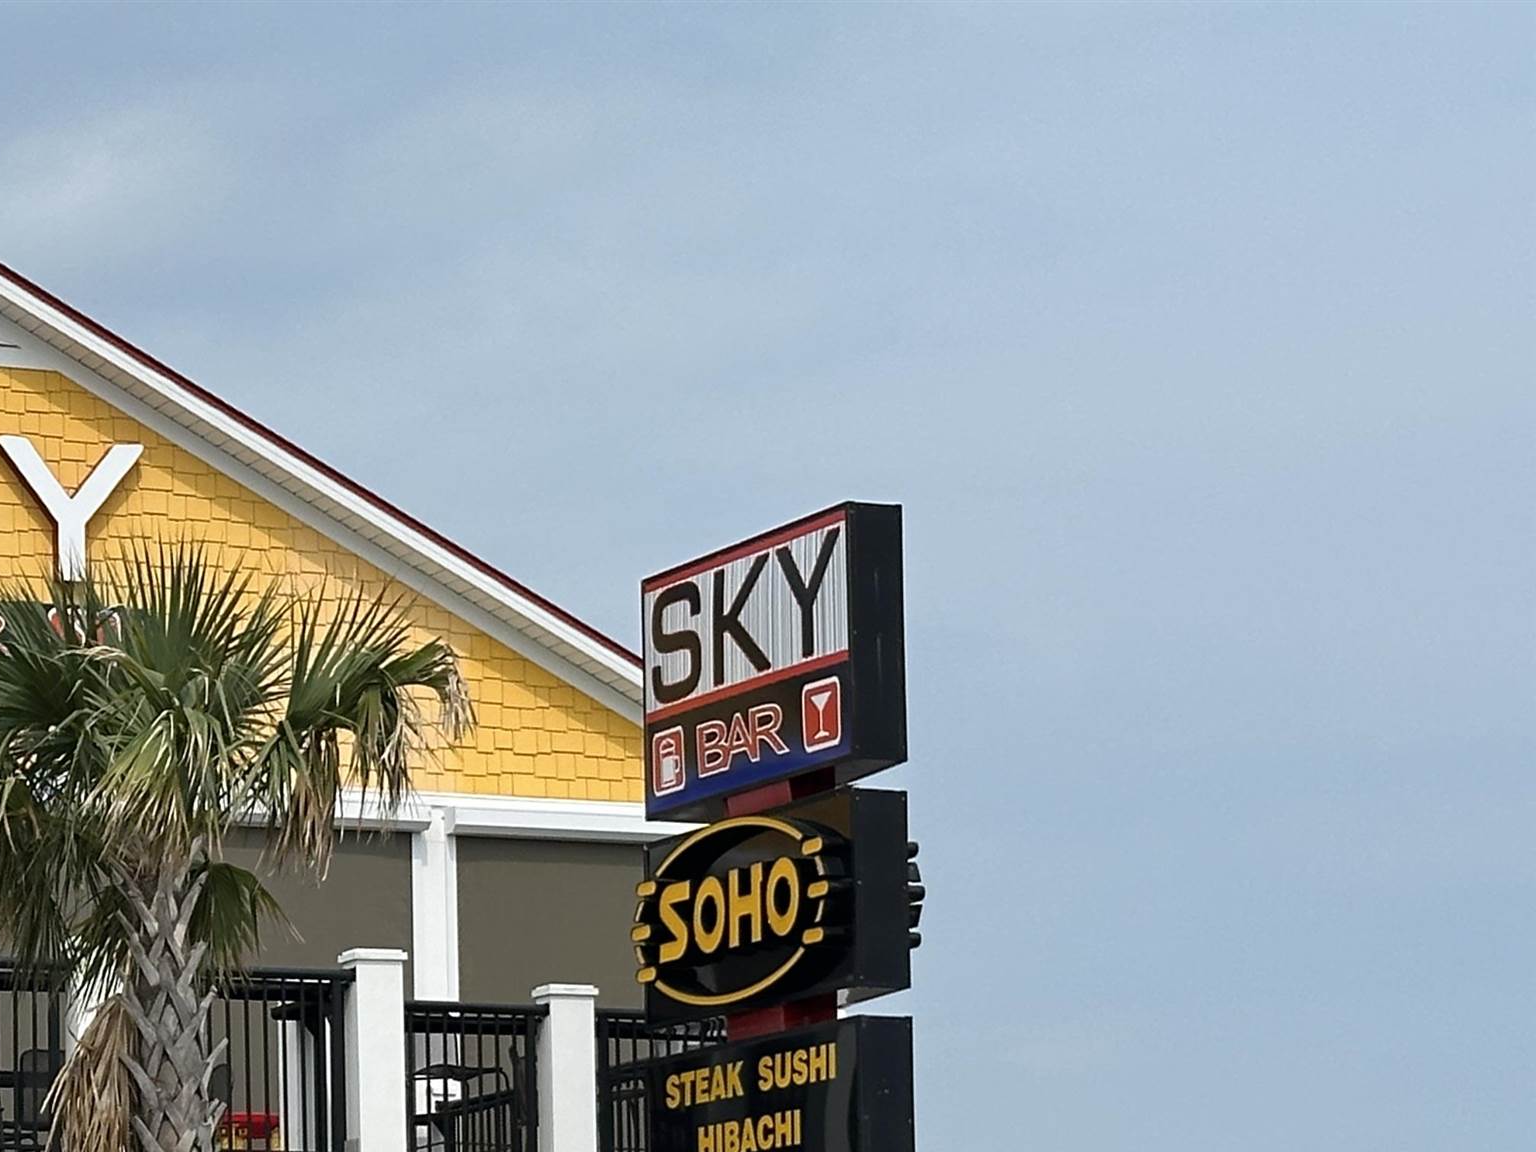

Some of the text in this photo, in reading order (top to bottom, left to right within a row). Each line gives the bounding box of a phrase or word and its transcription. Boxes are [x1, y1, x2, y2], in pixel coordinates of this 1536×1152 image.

[652, 526, 840, 704] SKY
[696, 703, 790, 778] BAR
[658, 856, 800, 963] SOHO
[665, 1042, 838, 1109] STEAK SUSHI
